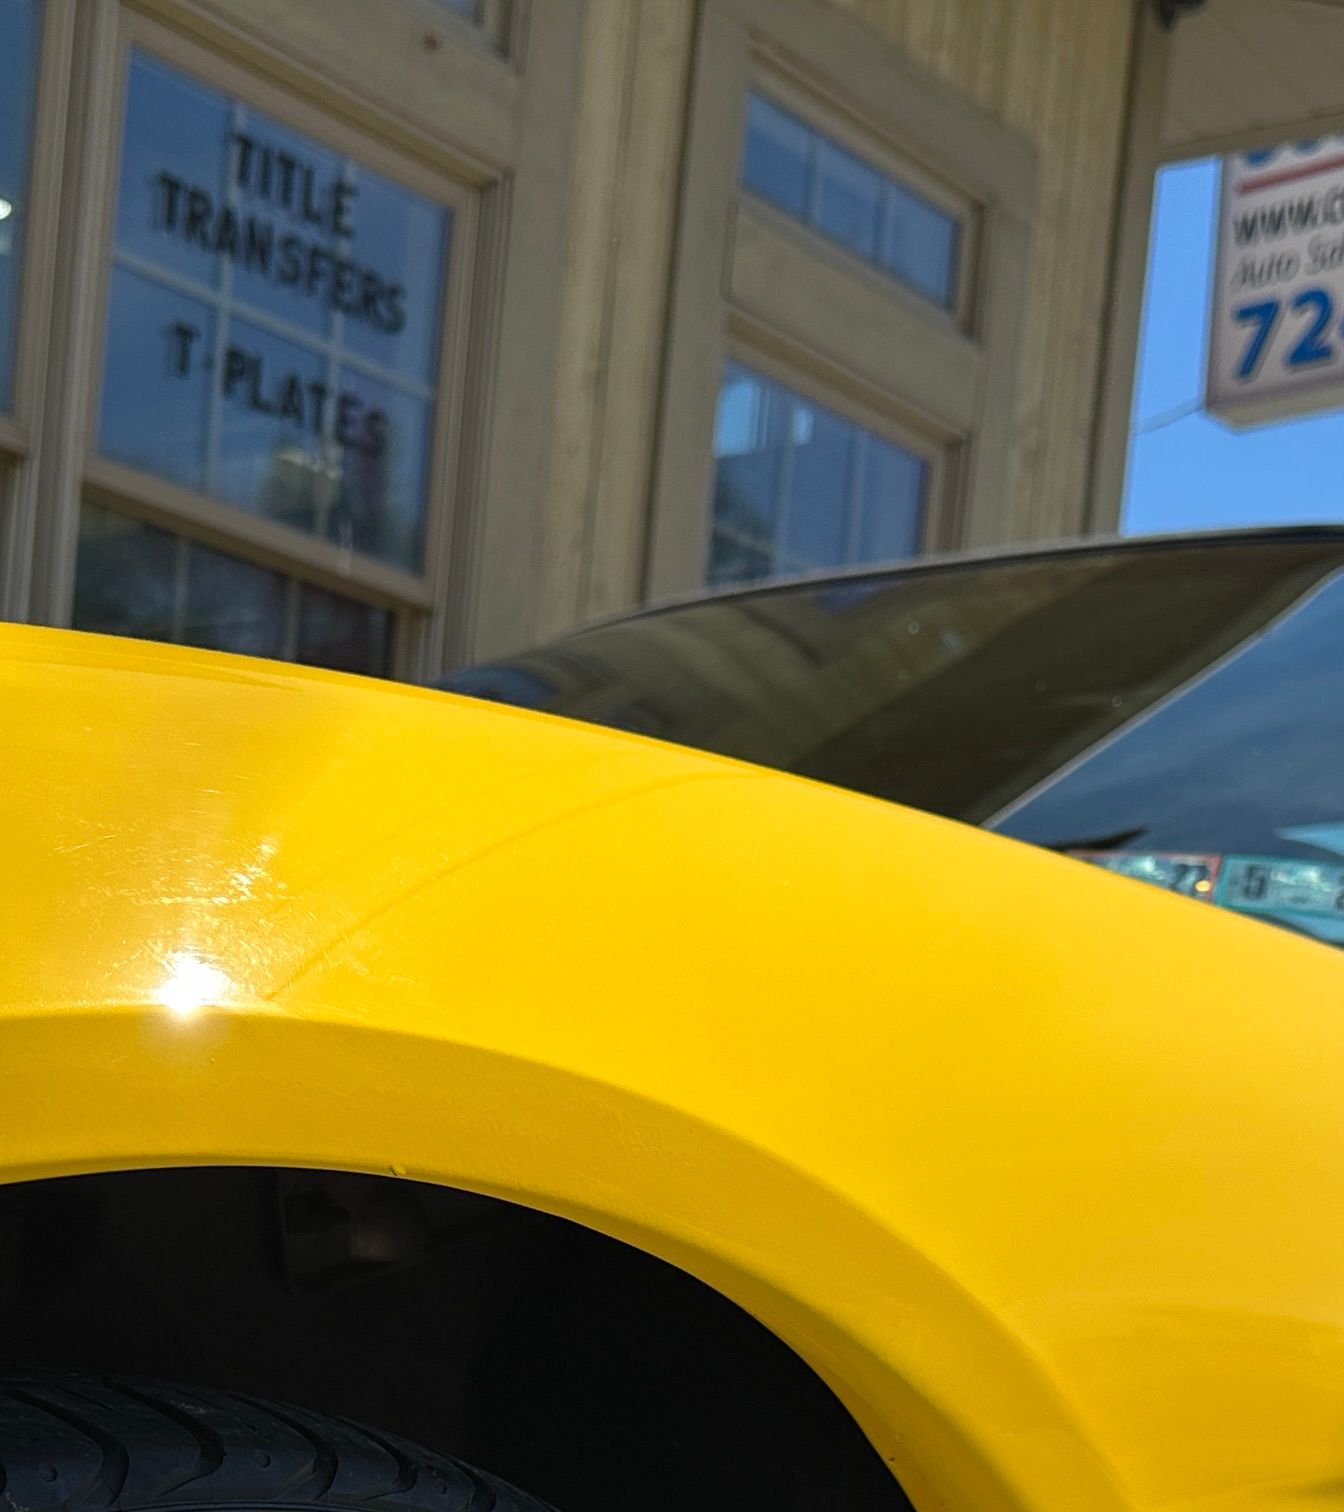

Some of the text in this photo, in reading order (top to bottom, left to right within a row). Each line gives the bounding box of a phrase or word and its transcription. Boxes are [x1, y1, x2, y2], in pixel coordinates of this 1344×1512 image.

[227, 130, 358, 238] TITLE
[153, 168, 408, 336] TRANSFERS
[1230, 250, 1301, 290] Auto
